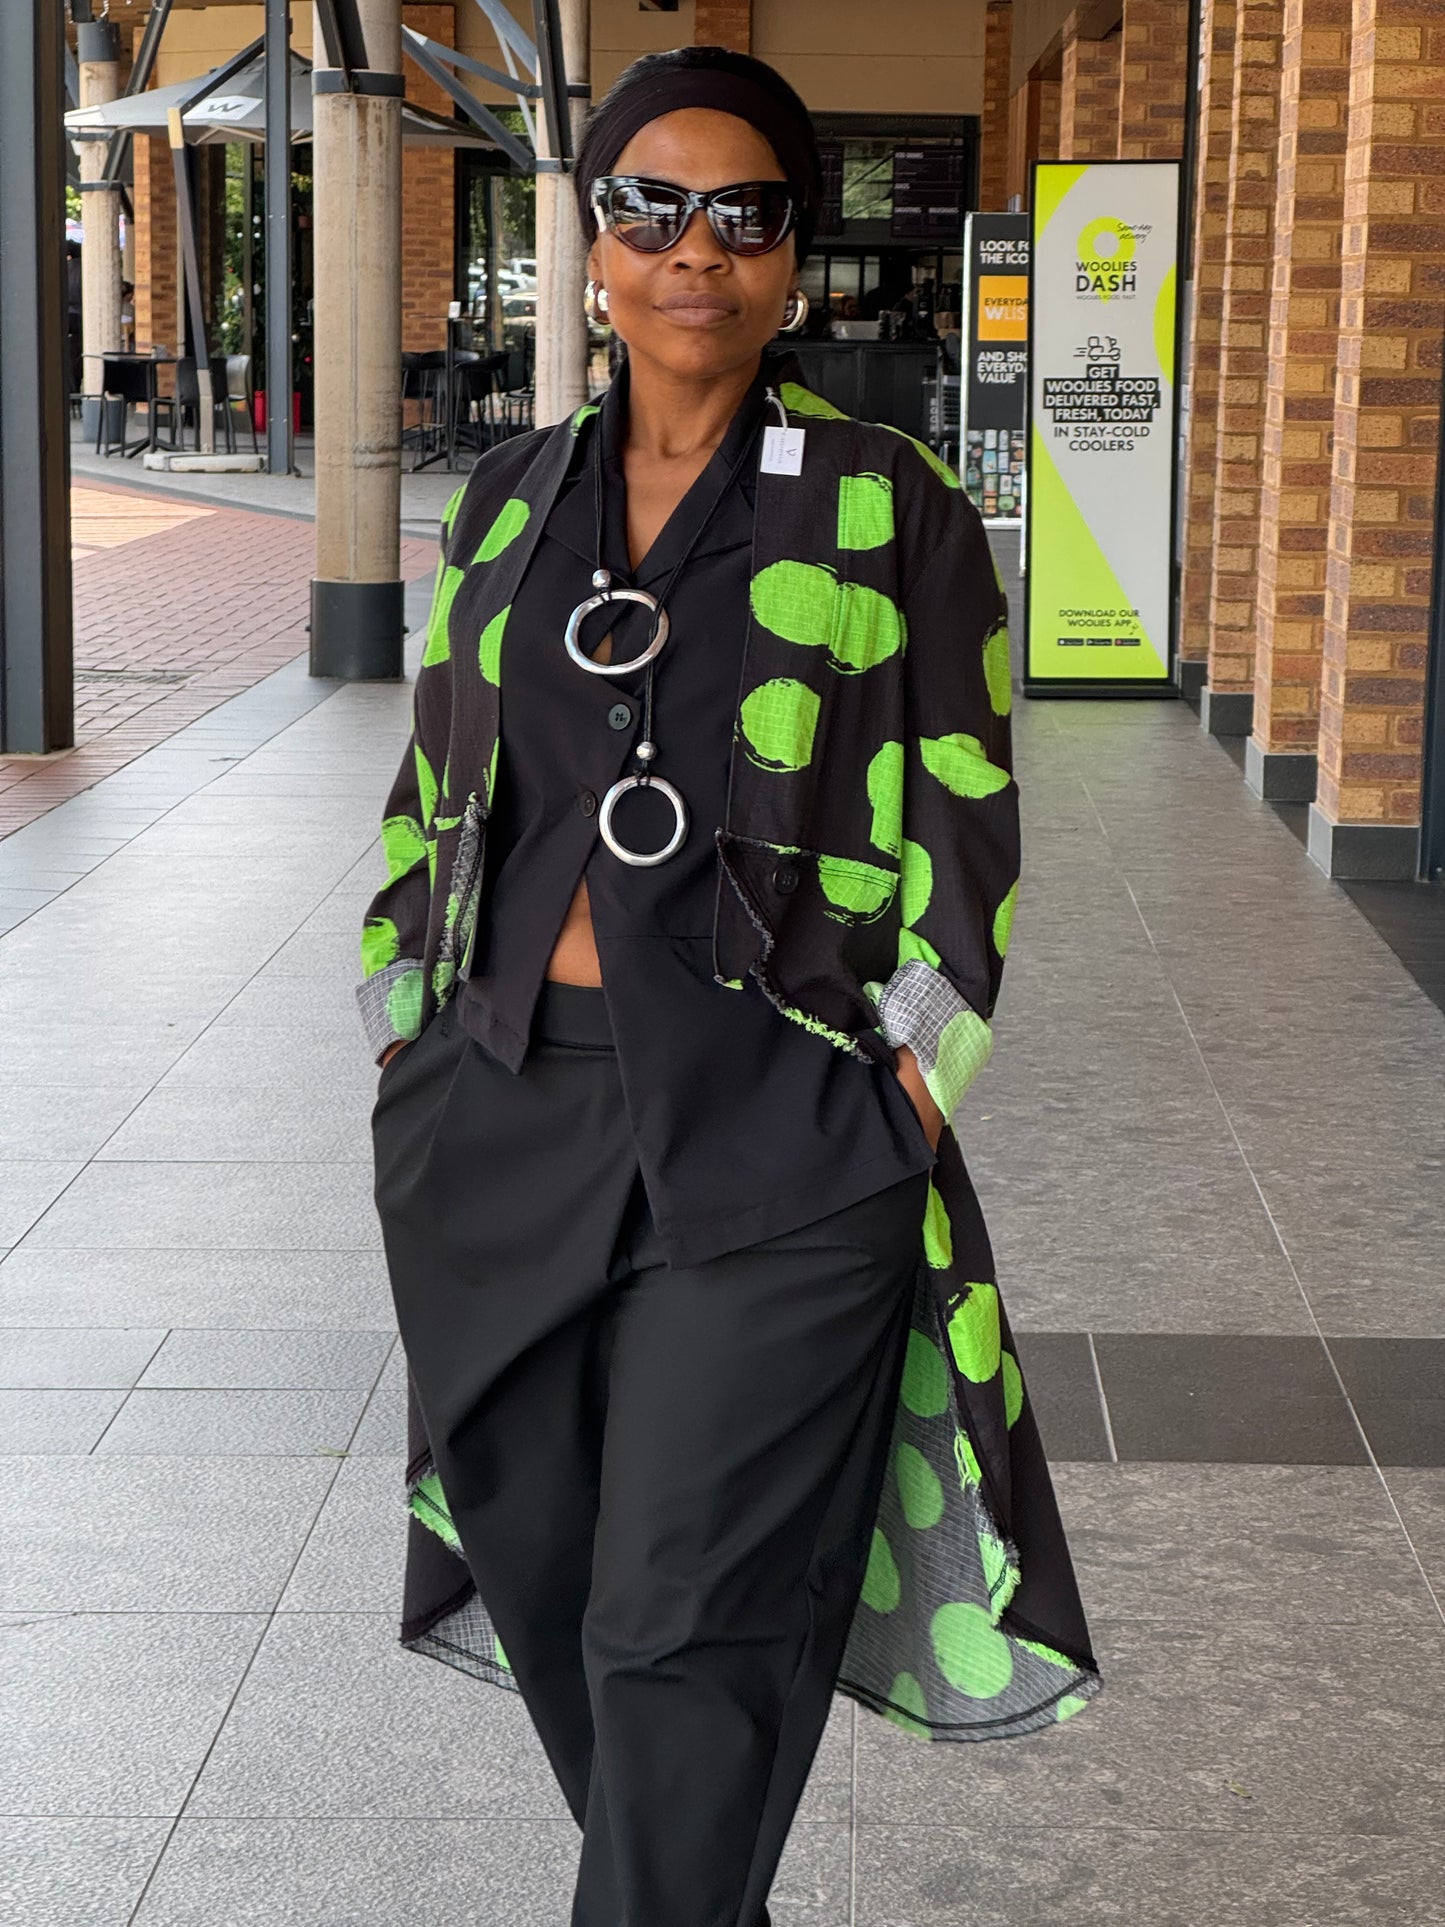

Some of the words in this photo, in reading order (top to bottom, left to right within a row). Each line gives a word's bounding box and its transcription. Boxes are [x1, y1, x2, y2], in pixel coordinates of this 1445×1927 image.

[980, 240, 1017, 252] LOOK
[979, 252, 1005, 265] THE
[1075, 261, 1138, 272] WOOLIES
[1075, 274, 1137, 292] DASH
[977, 351, 1006, 362] AND
[976, 372, 1017, 384] VALUE
[1088, 366, 1118, 379] GET
[1046, 380, 1113, 393] WOOLIES
[1114, 380, 1157, 392] FOOD
[1045, 394, 1120, 407] DELIVERED
[1121, 394, 1158, 408] FAST,
[1054, 408, 1103, 422] FRESH,
[1103, 408, 1151, 420] TODAY
[1053, 426, 1070, 438] IN
[1073, 426, 1151, 438] STAY-COLD
[1069, 439, 1135, 452] COOLERS
[1058, 609, 1117, 618] DOWNLOAD
[1118, 609, 1140, 618] OUR
[1067, 618, 1112, 627] WOOLIES
[1114, 618, 1132, 627] APP
